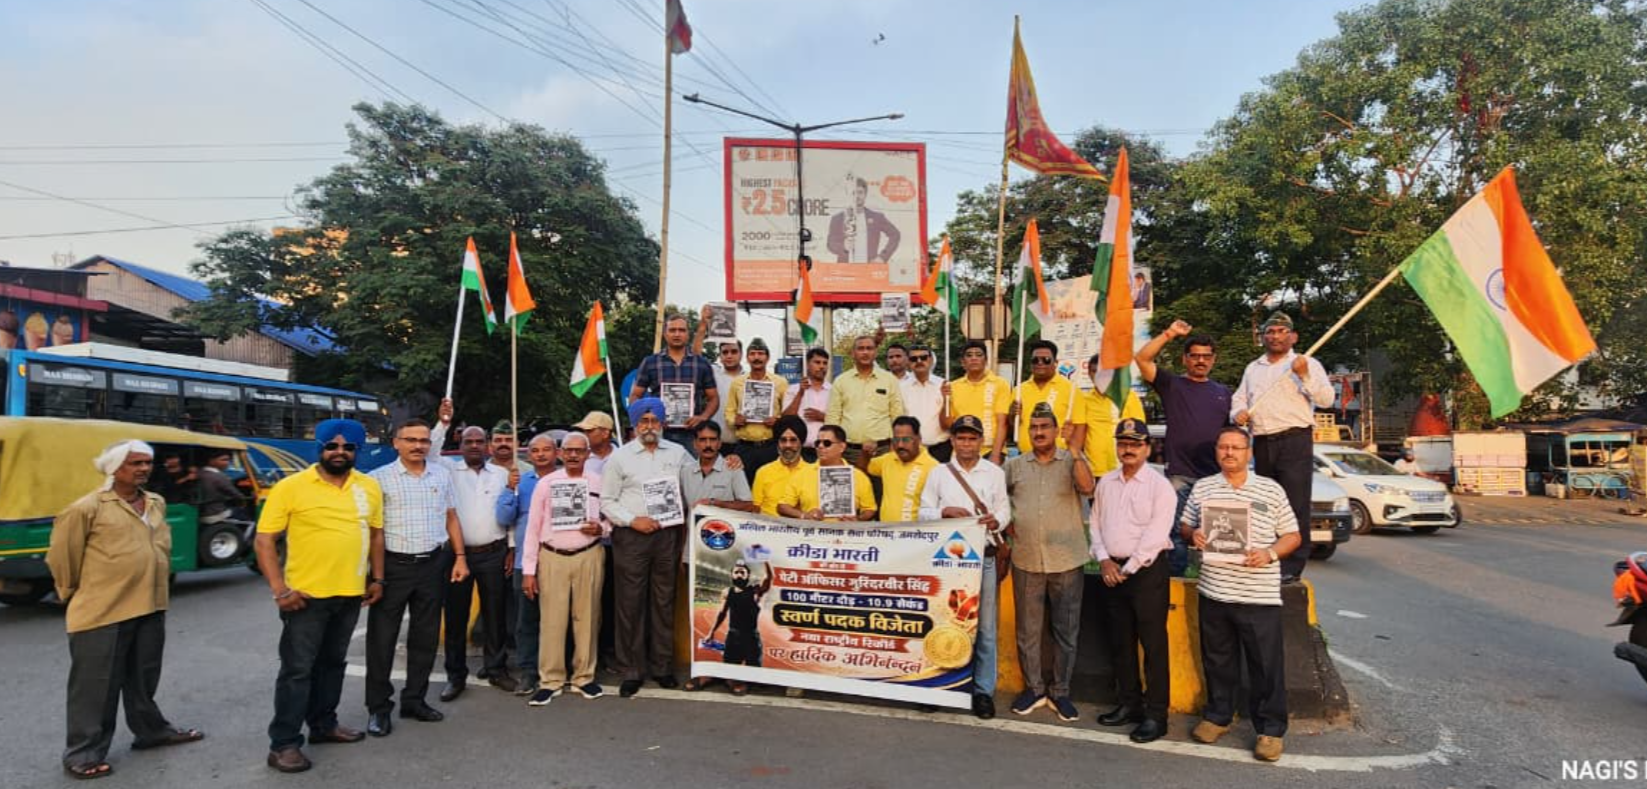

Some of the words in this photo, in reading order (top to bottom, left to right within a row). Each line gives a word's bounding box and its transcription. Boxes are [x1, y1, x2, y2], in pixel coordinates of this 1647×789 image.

[740, 178, 772, 188] HIGHEST
[741, 231, 771, 241] 2000
[768, 523, 800, 535] भारतीय
[898, 529, 940, 542] जमशेदपुर
[832, 546, 880, 562] भारती
[779, 571, 798, 583] पेटी
[801, 572, 846, 587] ऑफिसर
[906, 577, 931, 593] सिंह
[786, 592, 807, 602] 100
[809, 592, 834, 604] मीटर
[868, 598, 893, 608] 10.9
[780, 608, 820, 625] स्वर्ण
[823, 613, 866, 628] पदक
[869, 612, 925, 634] विजेता
[800, 632, 821, 643] नया
[823, 634, 859, 647] राष्ट्रीय
[768, 646, 787, 658] पर
[789, 645, 837, 663] हार्दिक
